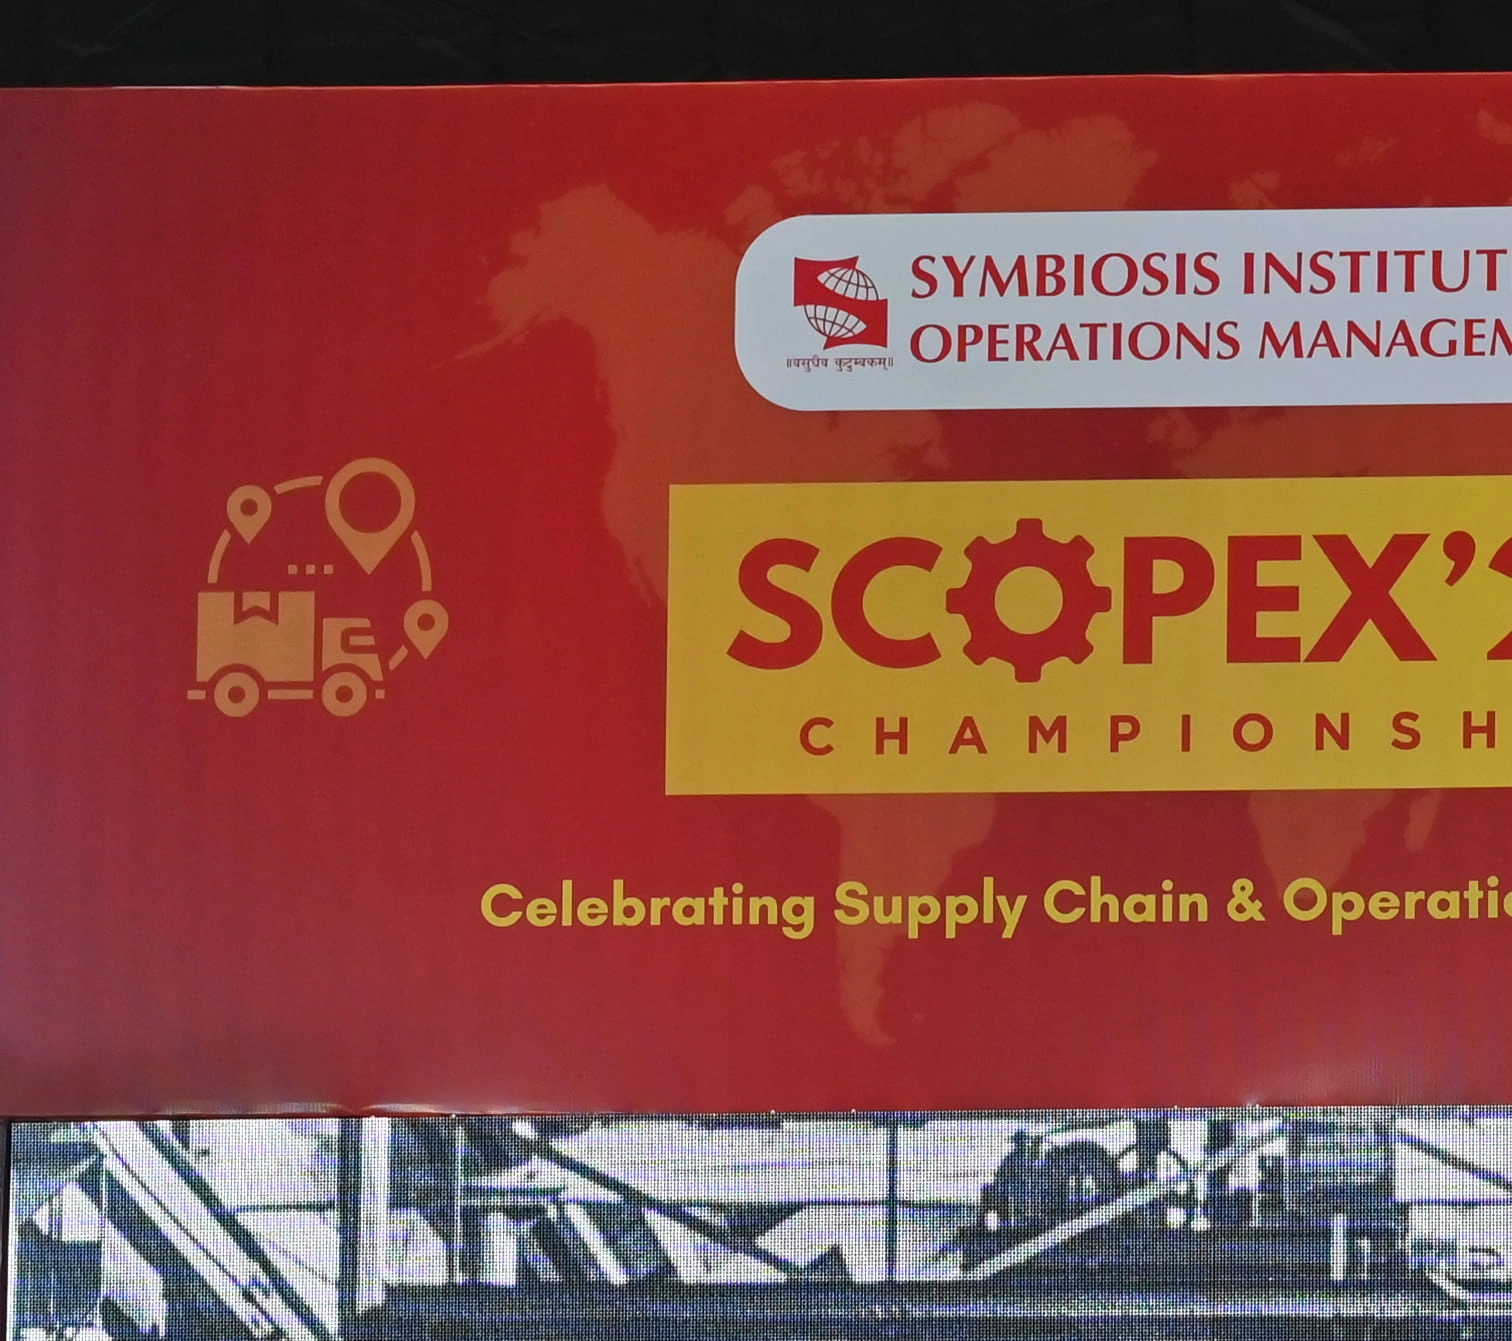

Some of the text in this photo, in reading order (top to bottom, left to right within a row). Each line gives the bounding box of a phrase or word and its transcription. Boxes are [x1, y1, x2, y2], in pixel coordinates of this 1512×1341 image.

[912, 252, 1220, 298] SYMBIOSIS
[910, 321, 1240, 363] OPERATIONS
[481, 880, 814, 939] Celebrating
[834, 877, 1027, 938] Supply
[1044, 876, 1208, 923] Chain
[1227, 879, 1265, 921] &
